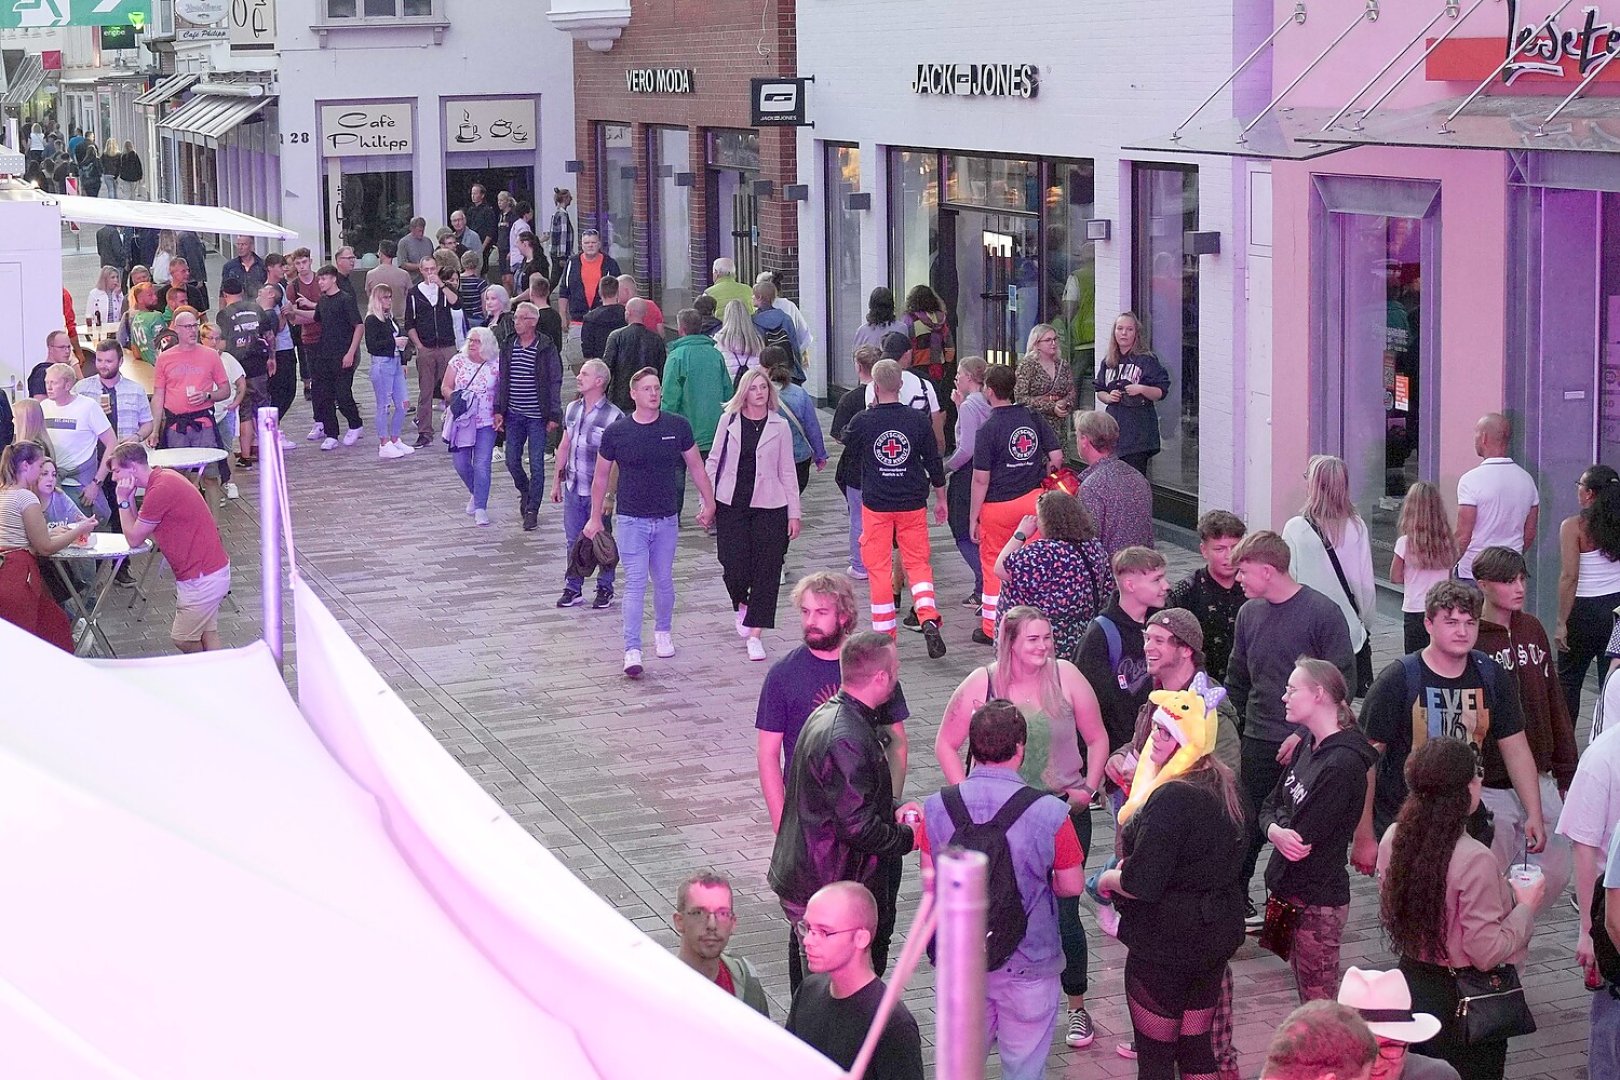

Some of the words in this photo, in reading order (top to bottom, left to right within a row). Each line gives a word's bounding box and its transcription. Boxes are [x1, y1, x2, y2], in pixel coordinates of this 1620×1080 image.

[625, 68, 654, 93] VERO
[656, 68, 690, 93] MODA
[326, 132, 408, 151] Philipp
